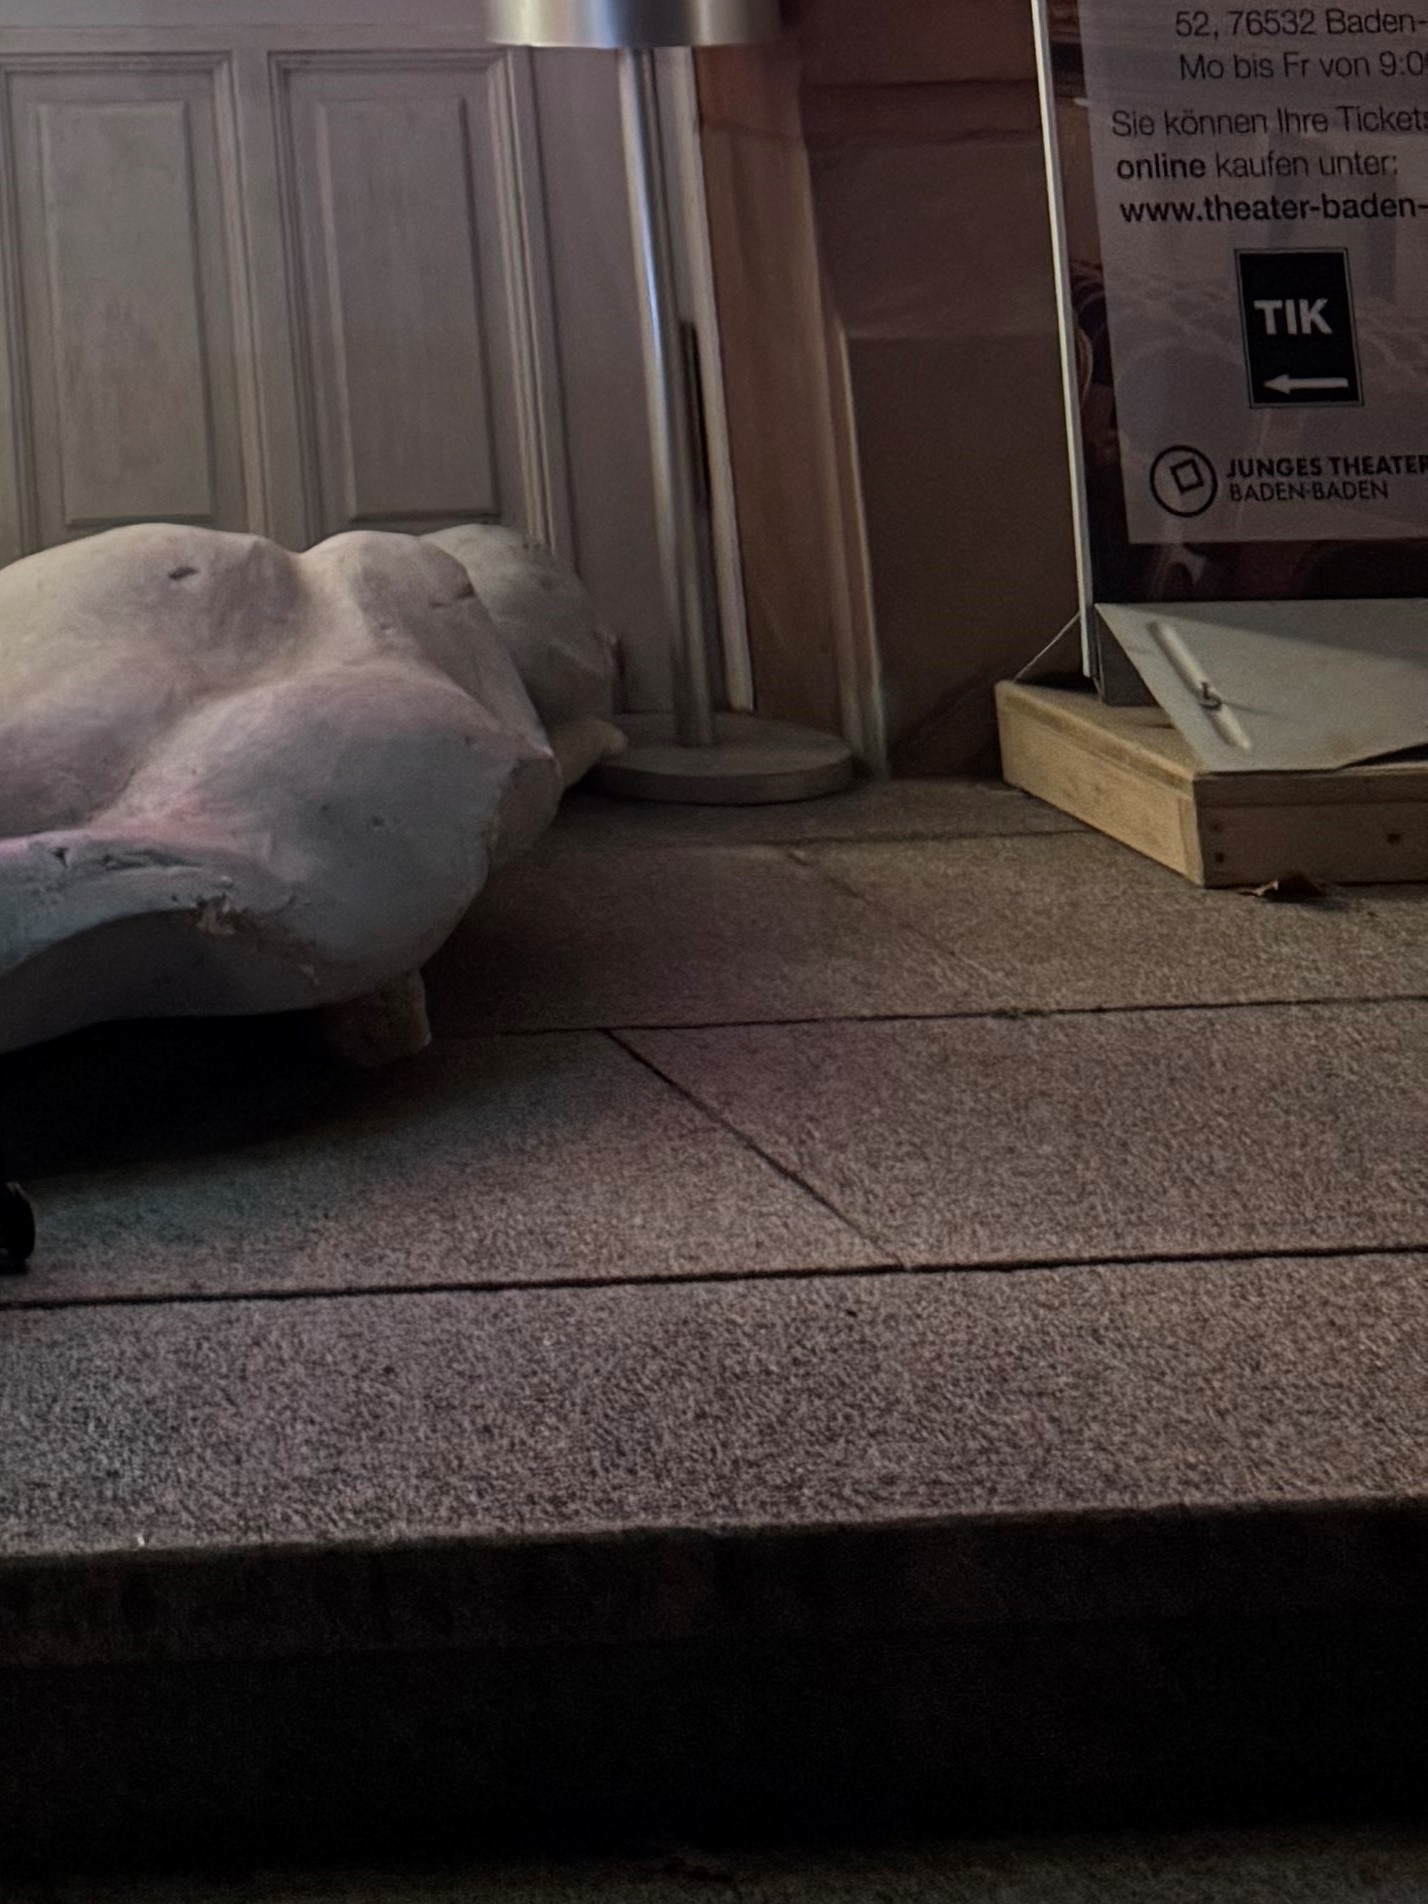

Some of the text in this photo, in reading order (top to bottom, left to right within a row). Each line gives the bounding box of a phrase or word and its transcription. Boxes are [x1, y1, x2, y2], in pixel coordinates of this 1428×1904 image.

[1176, 11, 1219, 40] 52,
[1229, 11, 1316, 36] 76532
[1180, 50, 1428, 80] Mo bis Fr von 9:0
[1112, 110, 1155, 136] Sie
[1165, 109, 1267, 135] können
[1278, 107, 1329, 132] Ihre
[1117, 153, 1397, 179] online kaufen unter:
[1254, 298, 1332, 335] TIK
[1226, 458, 1322, 478] JUNGES
[1229, 481, 1388, 502] BADEN-BADEN
